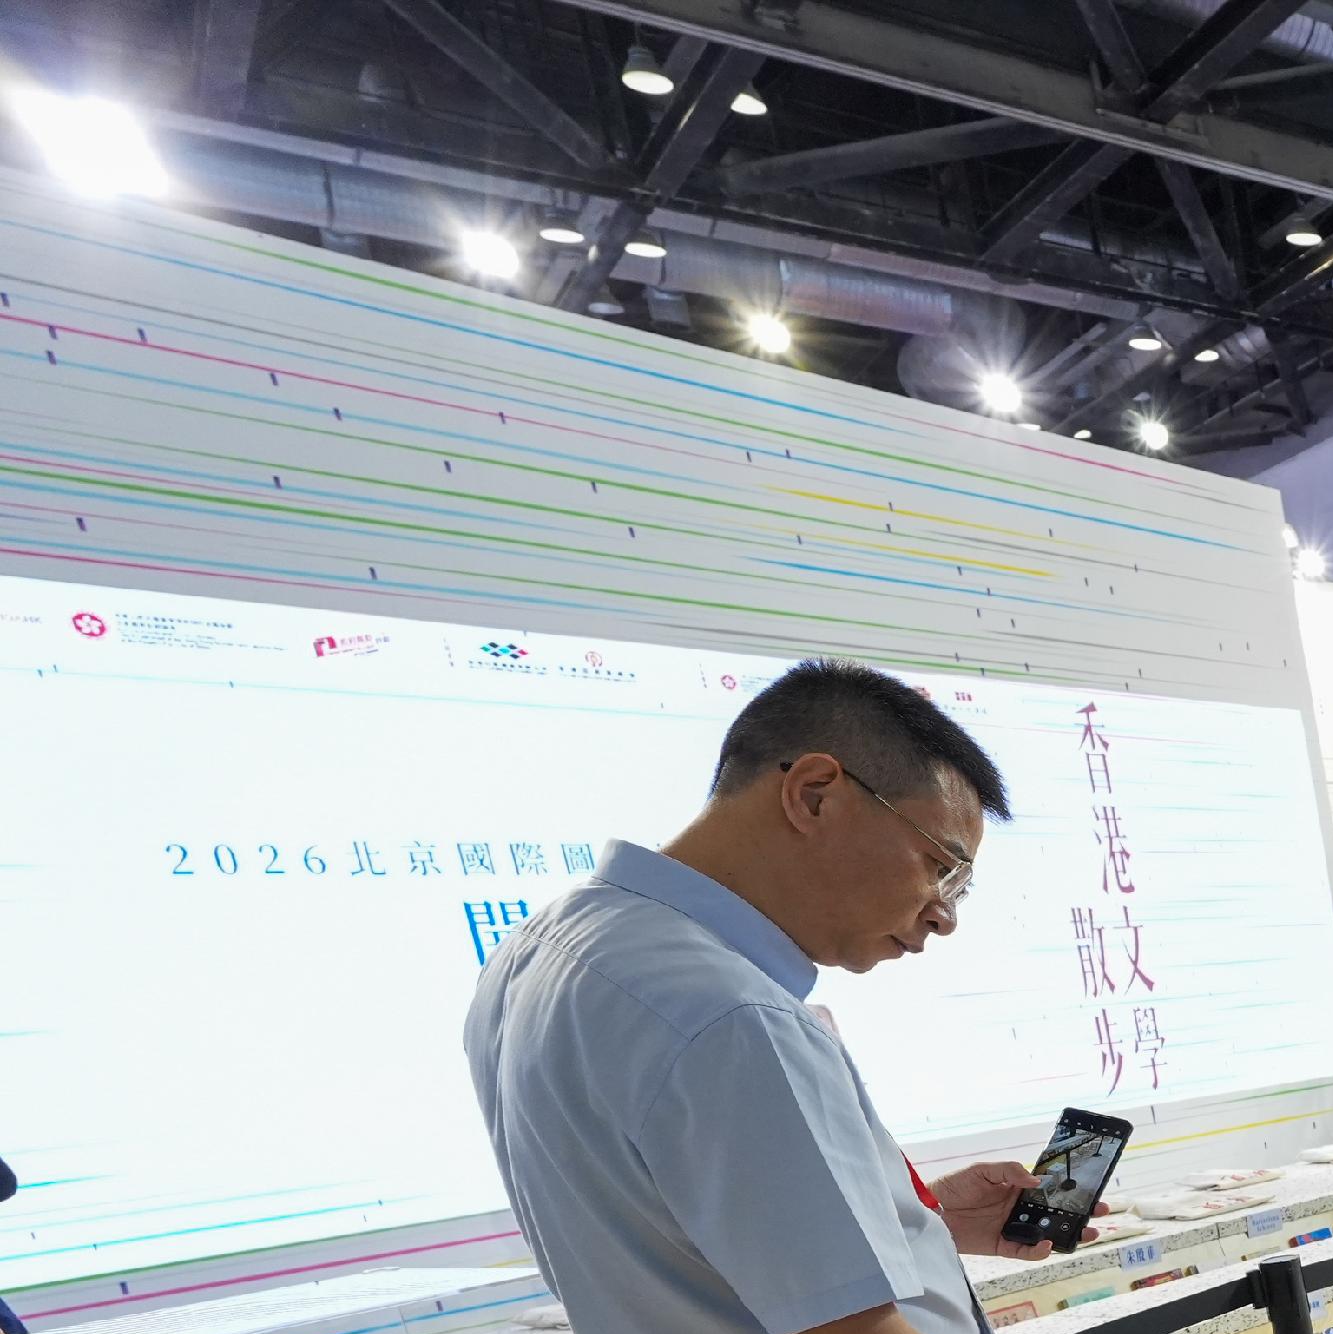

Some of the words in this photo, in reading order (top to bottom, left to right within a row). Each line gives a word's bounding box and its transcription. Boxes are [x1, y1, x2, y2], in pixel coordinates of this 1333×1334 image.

[1070, 905, 1125, 1097] 散步
[1073, 700, 1167, 1092] 香港文學
